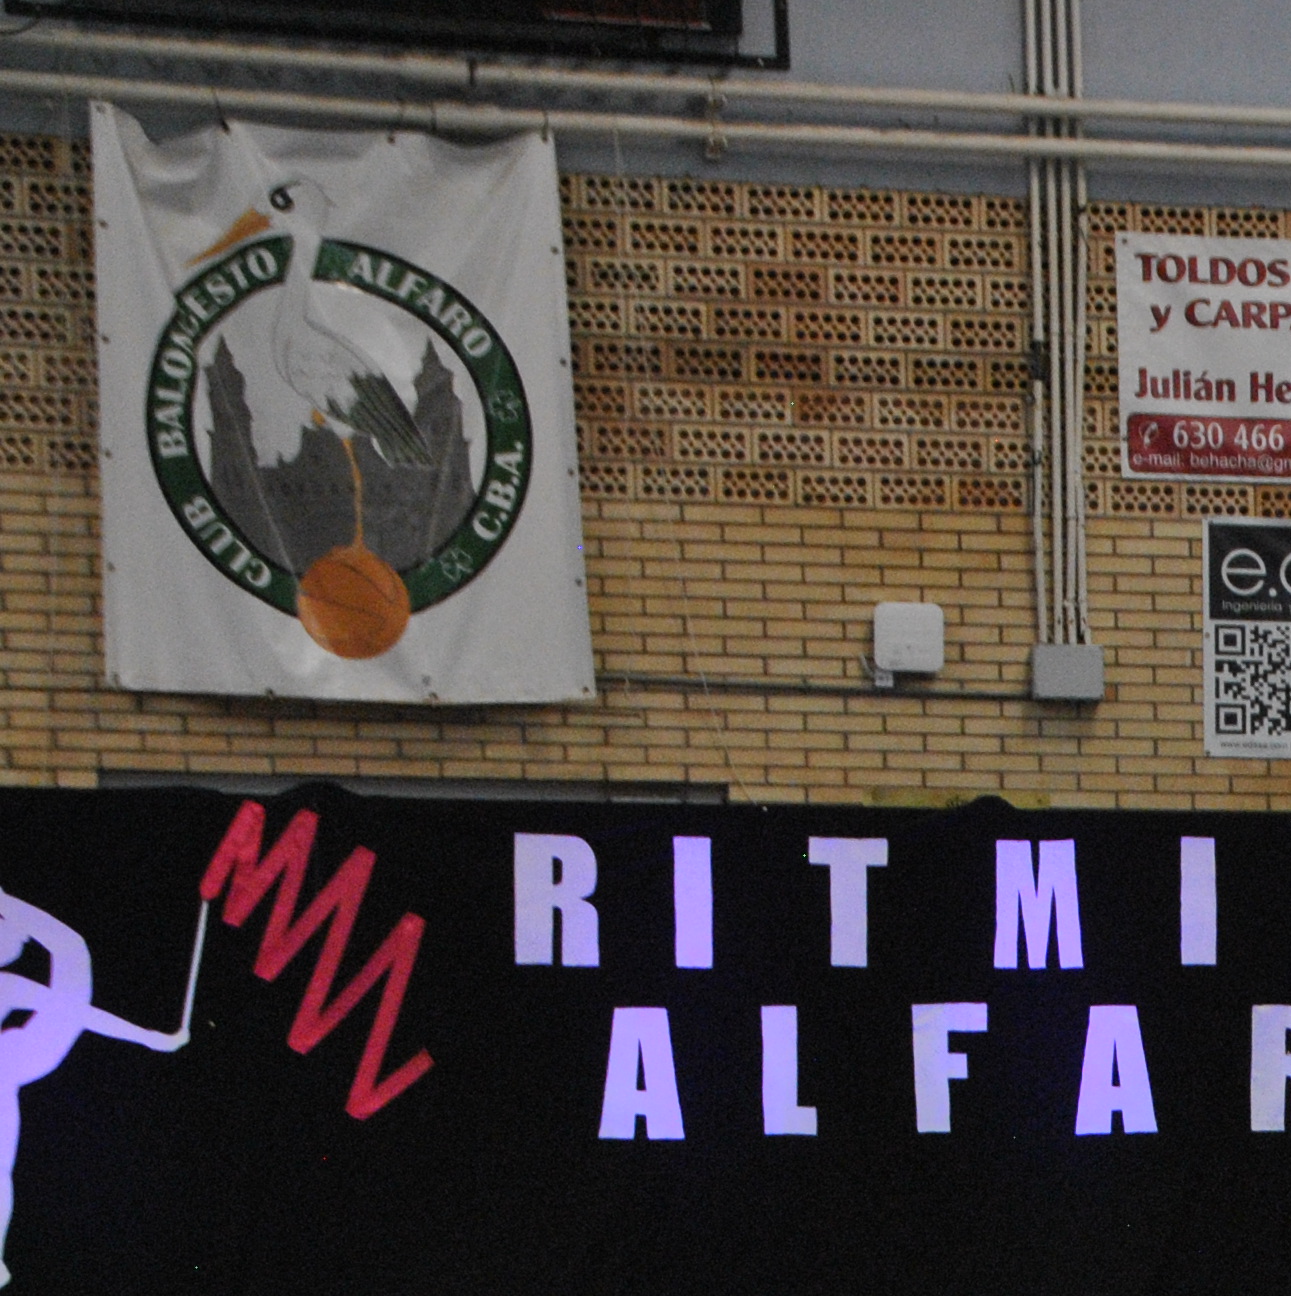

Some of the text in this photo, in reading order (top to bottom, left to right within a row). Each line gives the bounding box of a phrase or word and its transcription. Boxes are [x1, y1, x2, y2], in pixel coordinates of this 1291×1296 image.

[1134, 253, 1291, 287] TOLDOS
[348, 254, 494, 359] ALFARO
[1150, 303, 1171, 333] y
[1135, 366, 1235, 401] Julián
[1173, 419, 1223, 450] 630
[1234, 422, 1284, 451] 466
[472, 439, 524, 543] C.B.A.
[179, 494, 274, 589] CLUB
